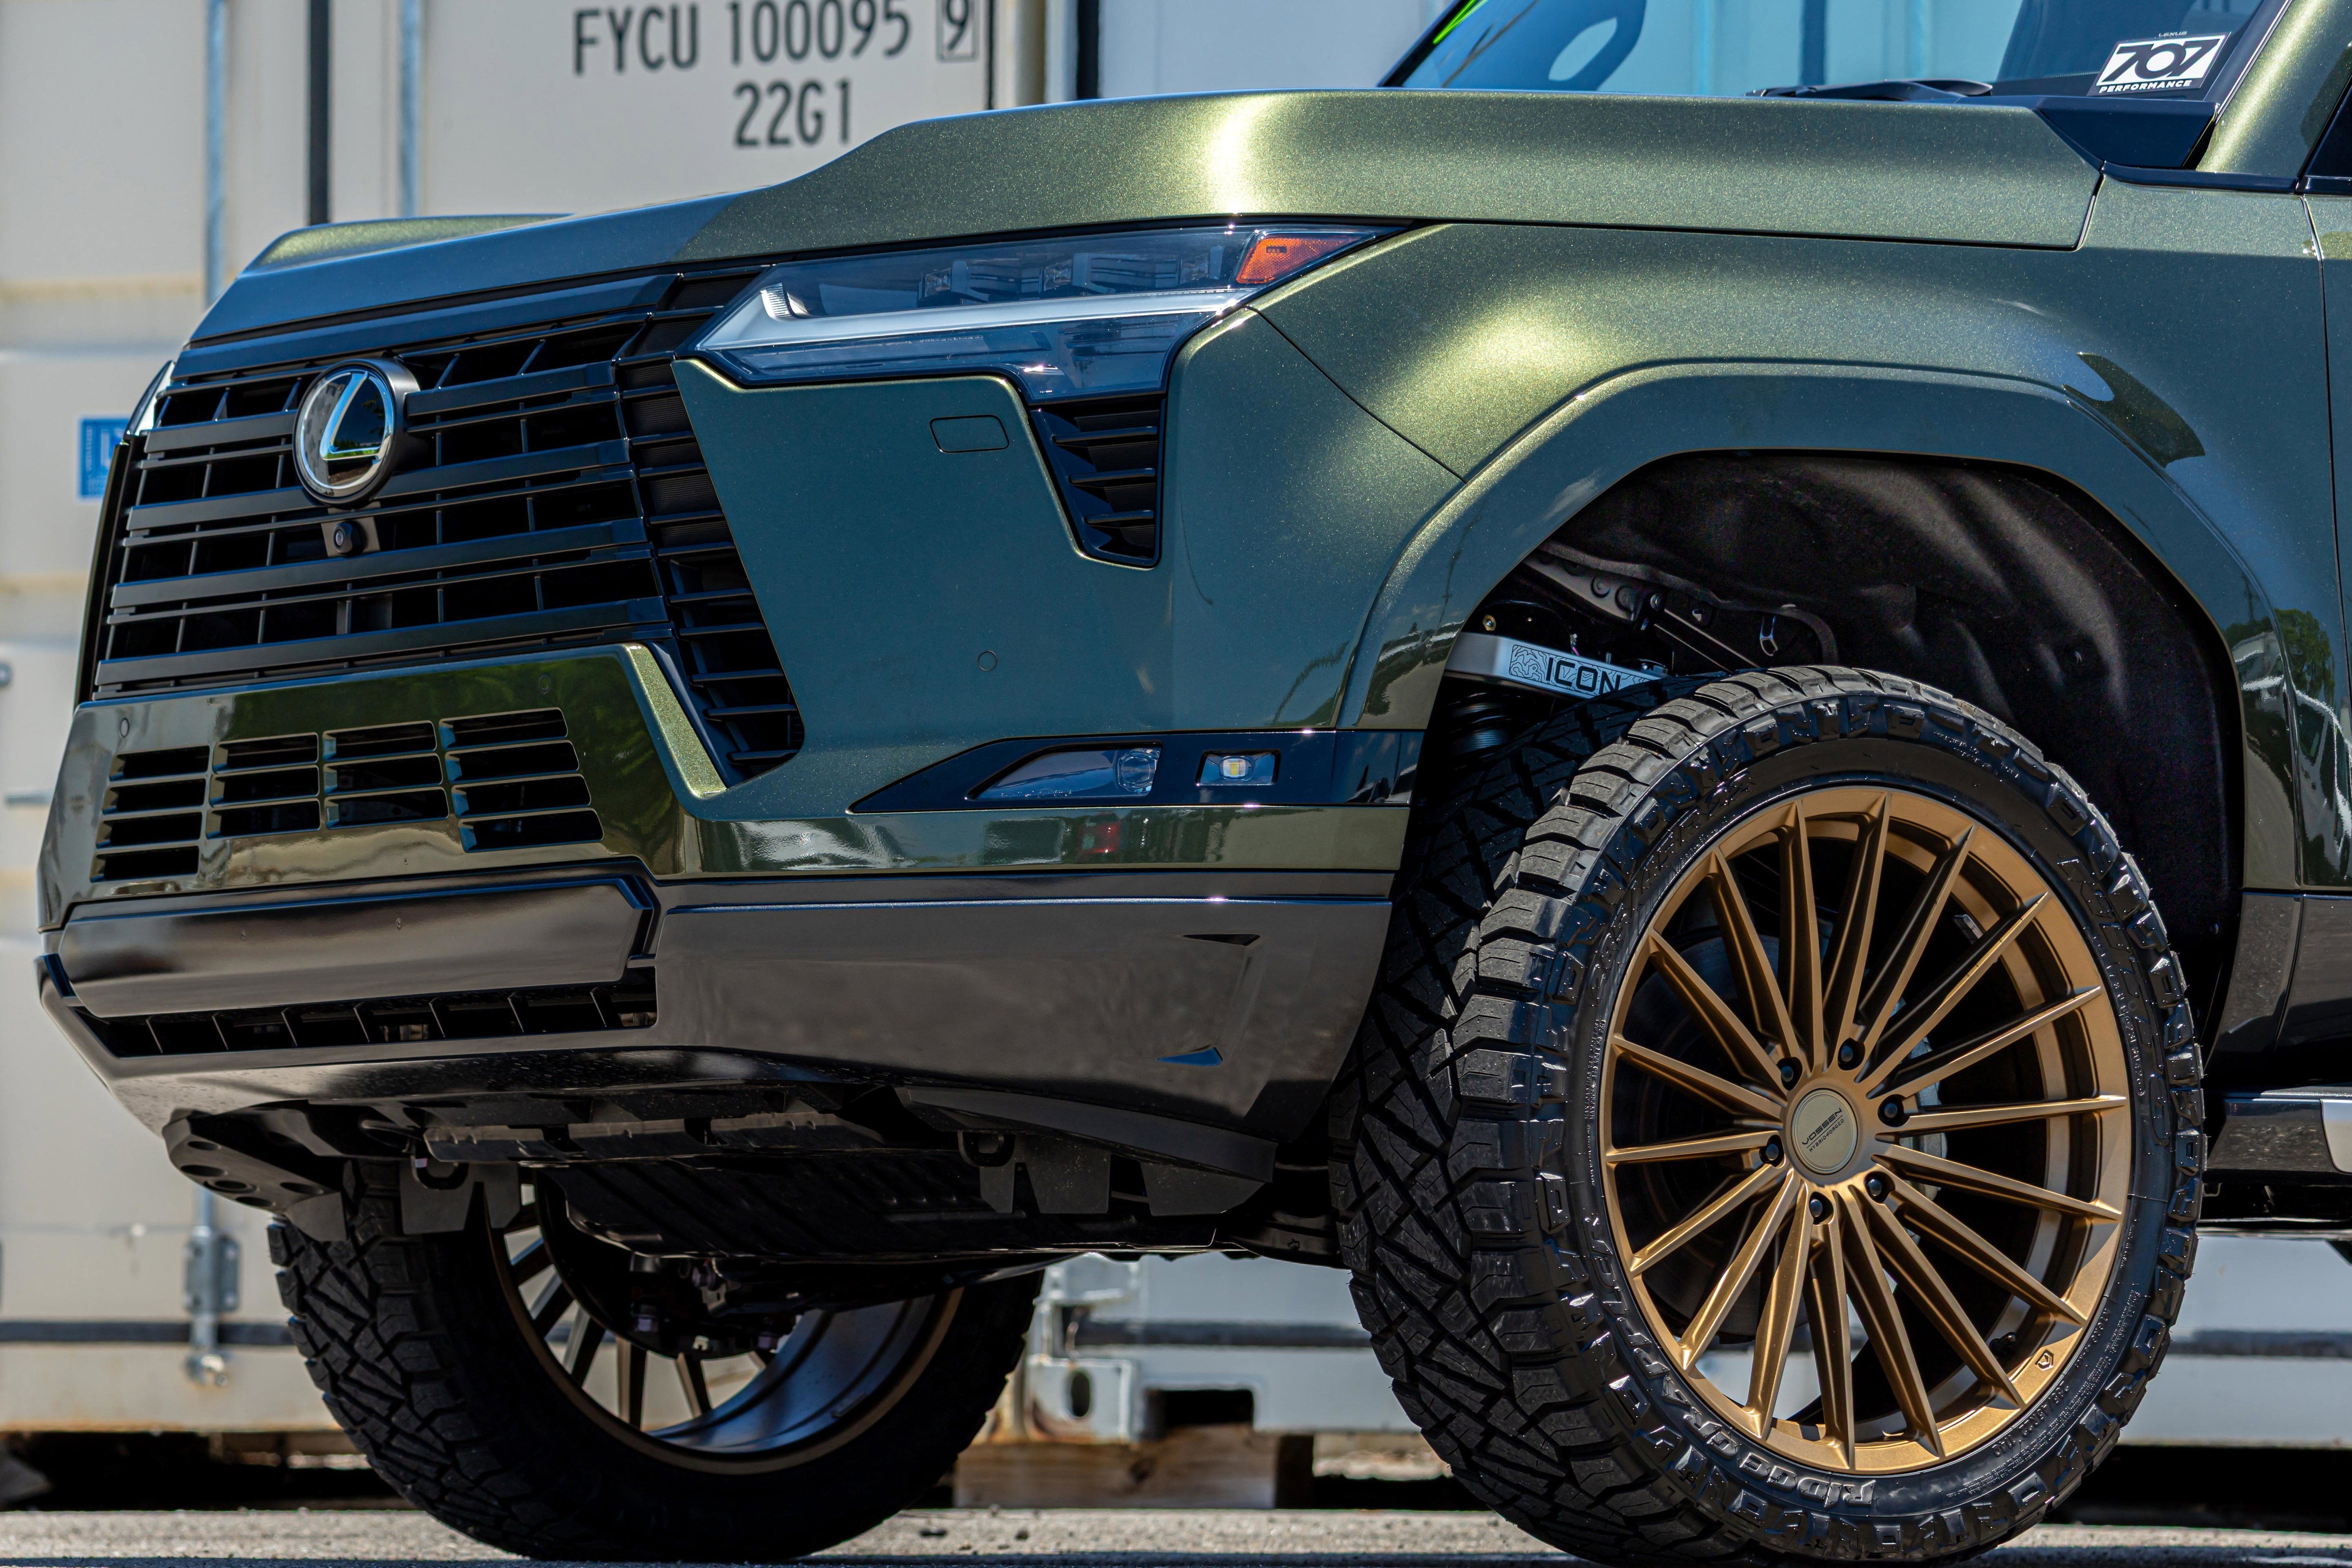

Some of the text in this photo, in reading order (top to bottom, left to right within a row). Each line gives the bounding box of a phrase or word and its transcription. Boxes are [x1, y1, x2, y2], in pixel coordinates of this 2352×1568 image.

[575, 5, 698, 75] FYCU
[728, 0, 911, 66] 100095
[2101, 39, 2222, 82] 707
[2098, 80, 2192, 94] PERFORMANCE
[734, 77, 852, 148] 22G1
[1546, 657, 1621, 695] ICON
[1802, 1108, 1842, 1145] VOSSEN
